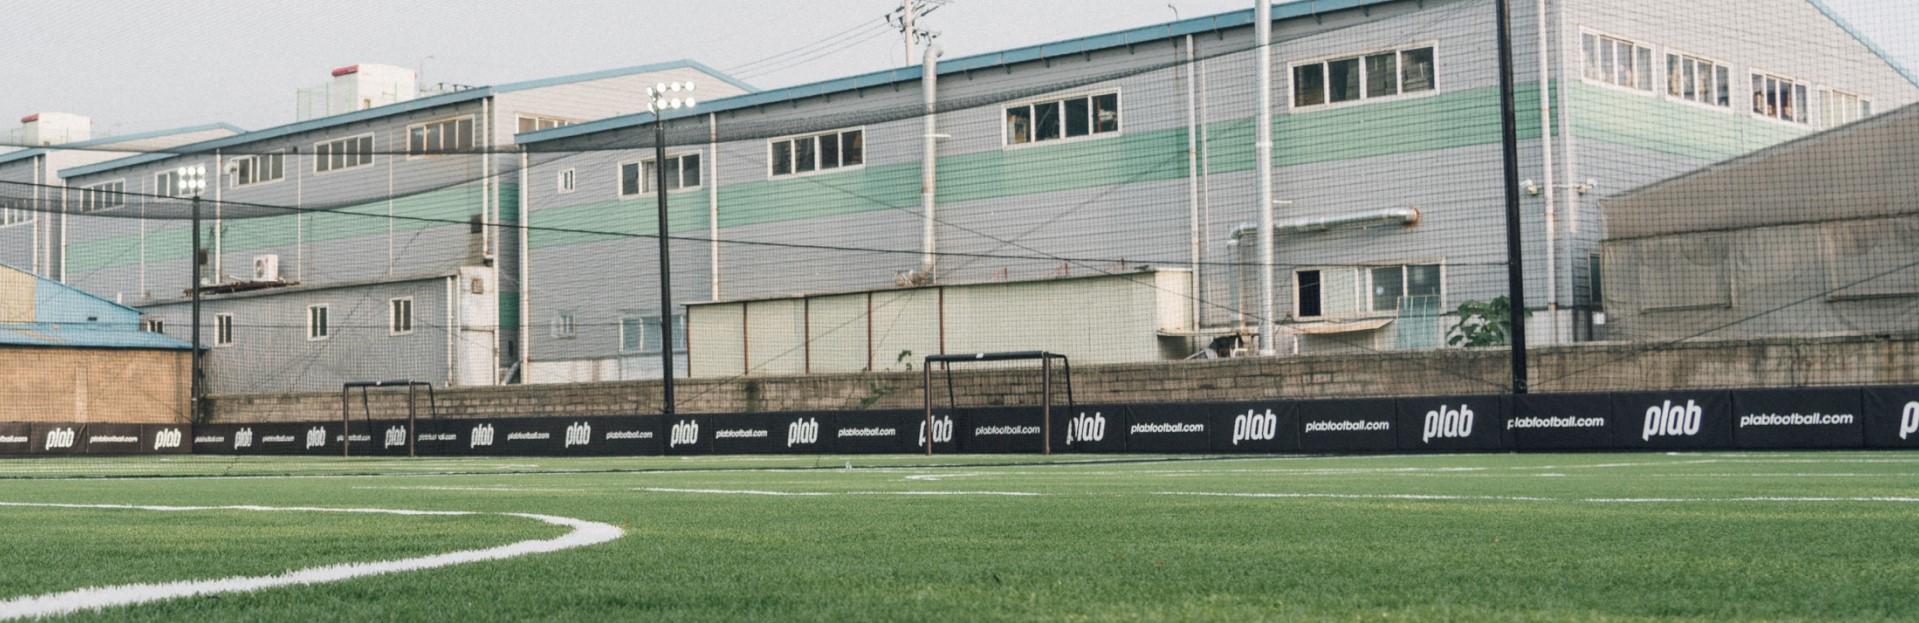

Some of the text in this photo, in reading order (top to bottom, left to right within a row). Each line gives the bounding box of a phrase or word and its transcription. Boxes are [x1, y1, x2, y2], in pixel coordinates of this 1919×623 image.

[974, 426, 1040, 436] plabfootball.com
[1066, 412, 1105, 444] plab
[1130, 423, 1204, 434] plabfootball.com
[1232, 409, 1276, 445] plab
[1305, 420, 1389, 432] plabfootball.com
[1422, 404, 1473, 443] plab
[1506, 416, 1604, 429] plabfootball.com
[1642, 400, 1701, 441] plab
[1739, 413, 1853, 427] plabfootball.com
[45, 428, 74, 450] plab
[153, 428, 181, 450] plab
[384, 425, 406, 448] plab
[470, 424, 494, 448] plab
[565, 422, 591, 448] plab
[670, 420, 698, 448] plab
[715, 429, 767, 439] plabfootball.com
[787, 418, 818, 447] plab
[837, 428, 895, 437] plabfootball.com
